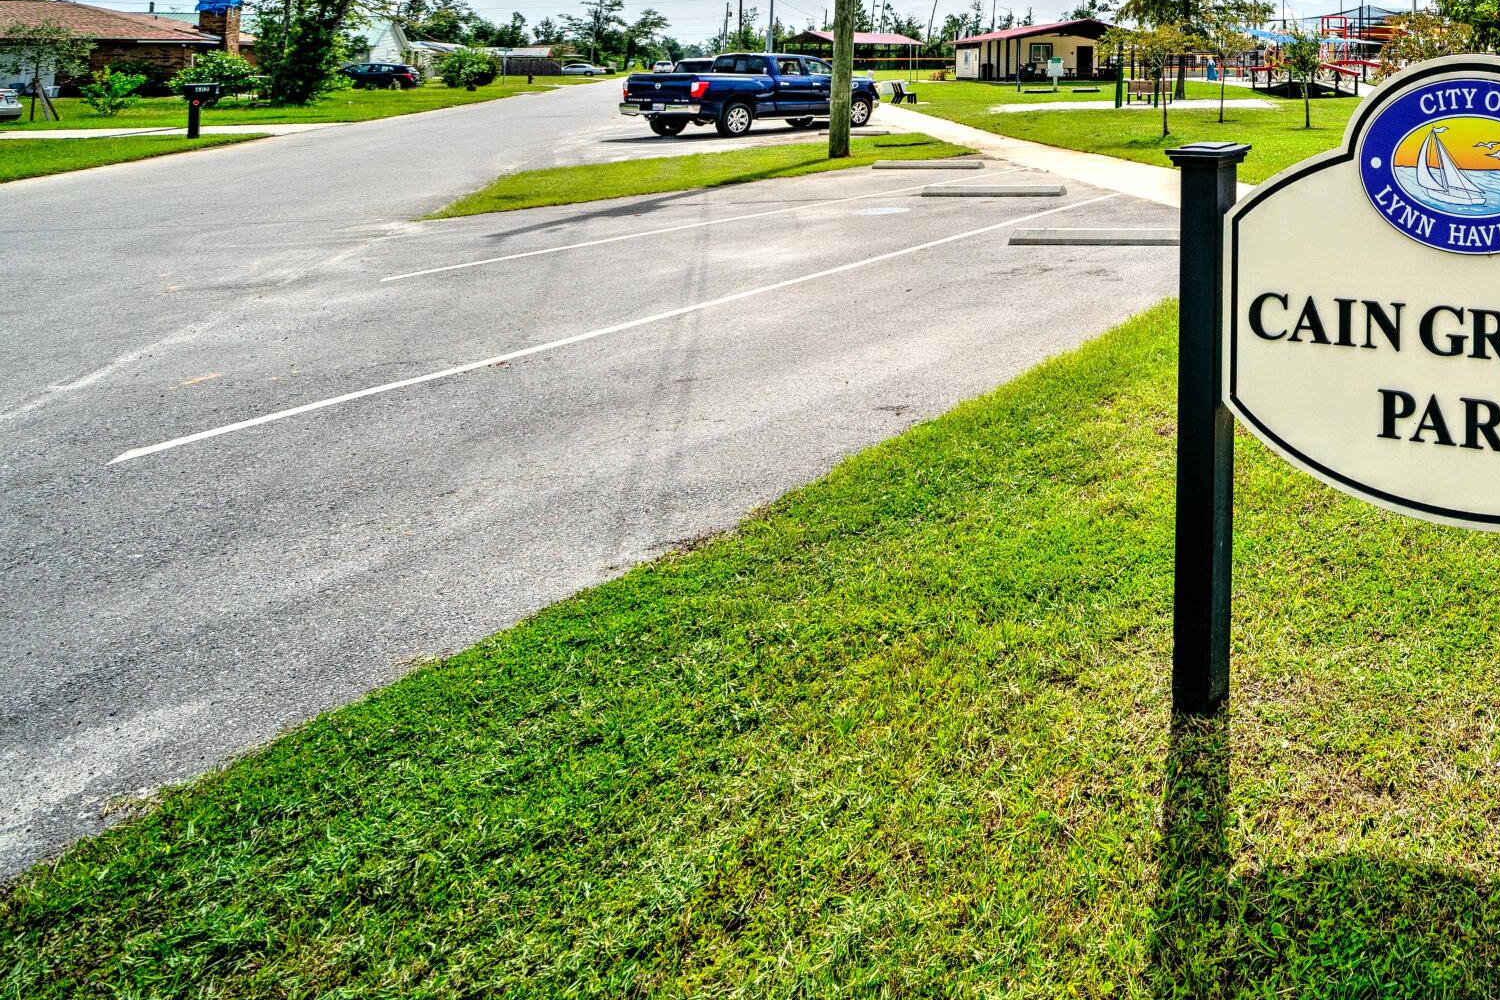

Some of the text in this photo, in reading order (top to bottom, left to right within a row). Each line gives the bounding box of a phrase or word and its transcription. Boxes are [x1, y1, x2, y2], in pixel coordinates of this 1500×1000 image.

[1419, 88, 1478, 115] CITY
[1374, 184, 1436, 238] LYNN
[1248, 292, 1406, 353] CAIN
